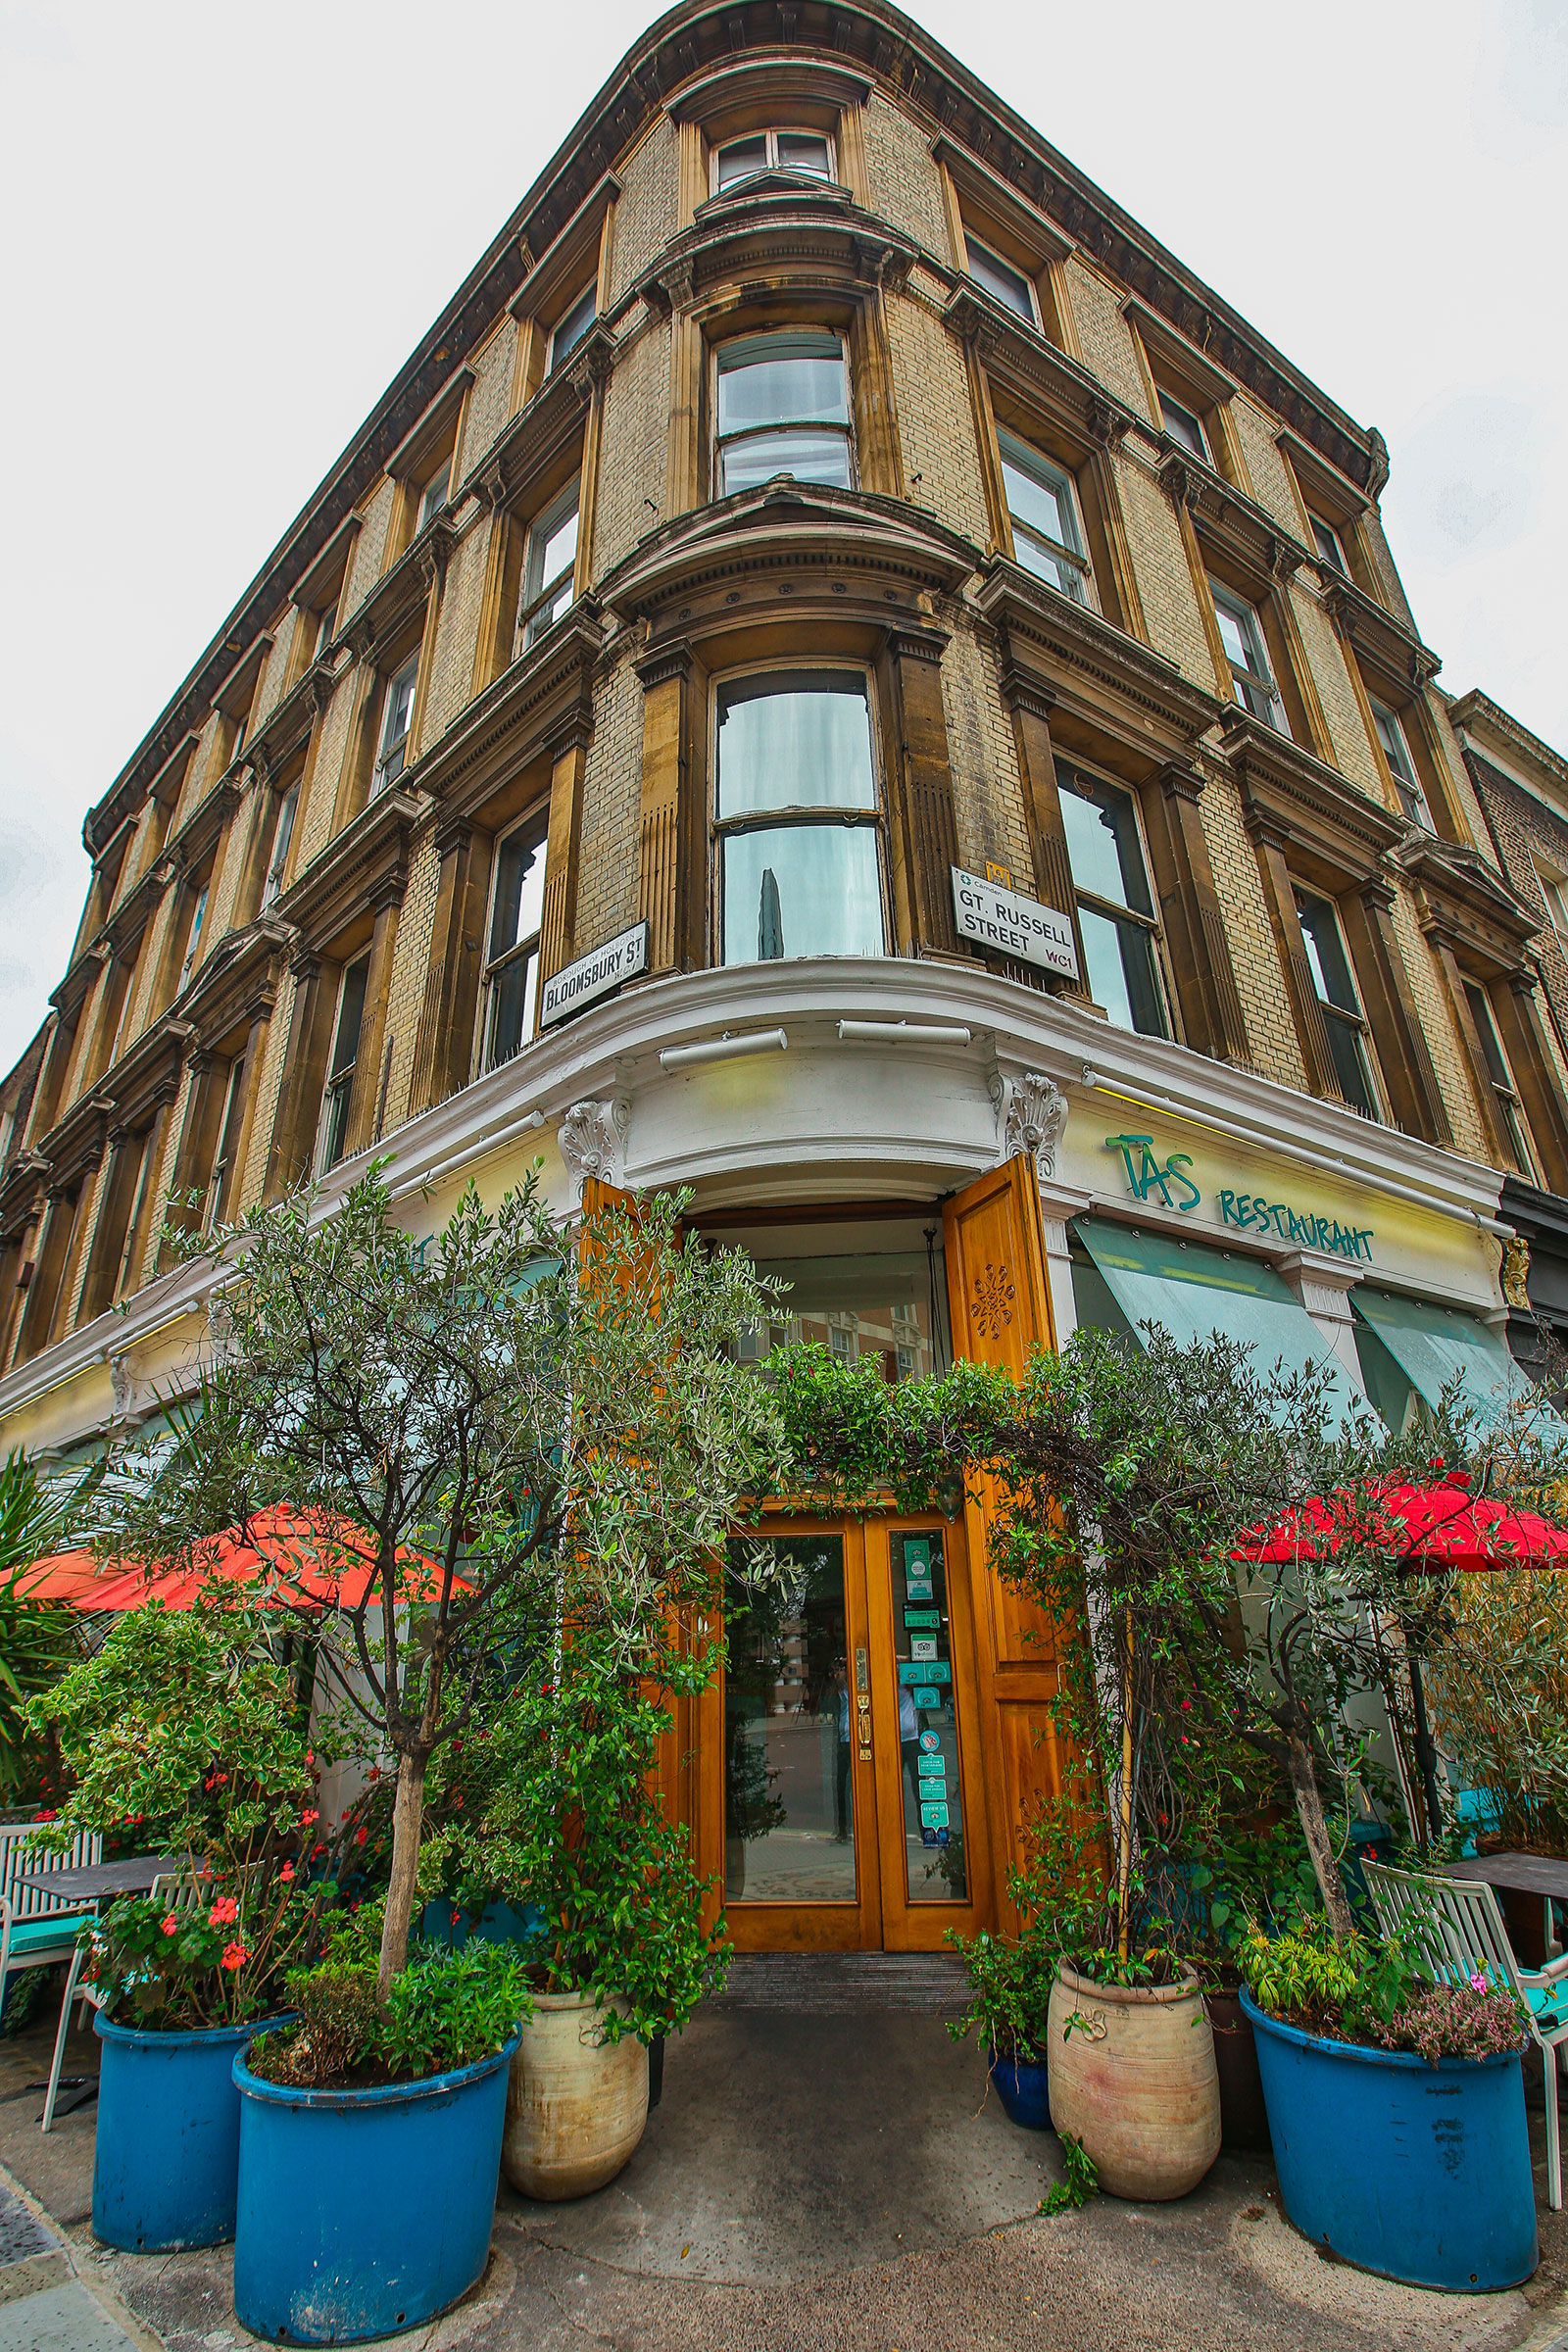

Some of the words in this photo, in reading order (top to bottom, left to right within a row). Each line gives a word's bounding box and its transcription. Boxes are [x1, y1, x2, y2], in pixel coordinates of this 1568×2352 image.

[974, 881, 1003, 897] Camden
[959, 889, 989, 914] GT.
[996, 903, 1071, 948] RUSSELL
[964, 913, 1029, 952] STREET
[547, 949, 623, 1011] BLOOMSBURY
[553, 962, 586, 987] BOROUGH
[589, 954, 598, 965] OF
[601, 933, 635, 957] HOLBORN
[1045, 949, 1072, 969] WC1
[1105, 1133, 1201, 1211] TAS
[1219, 1190, 1374, 1262] RESTAURANT
